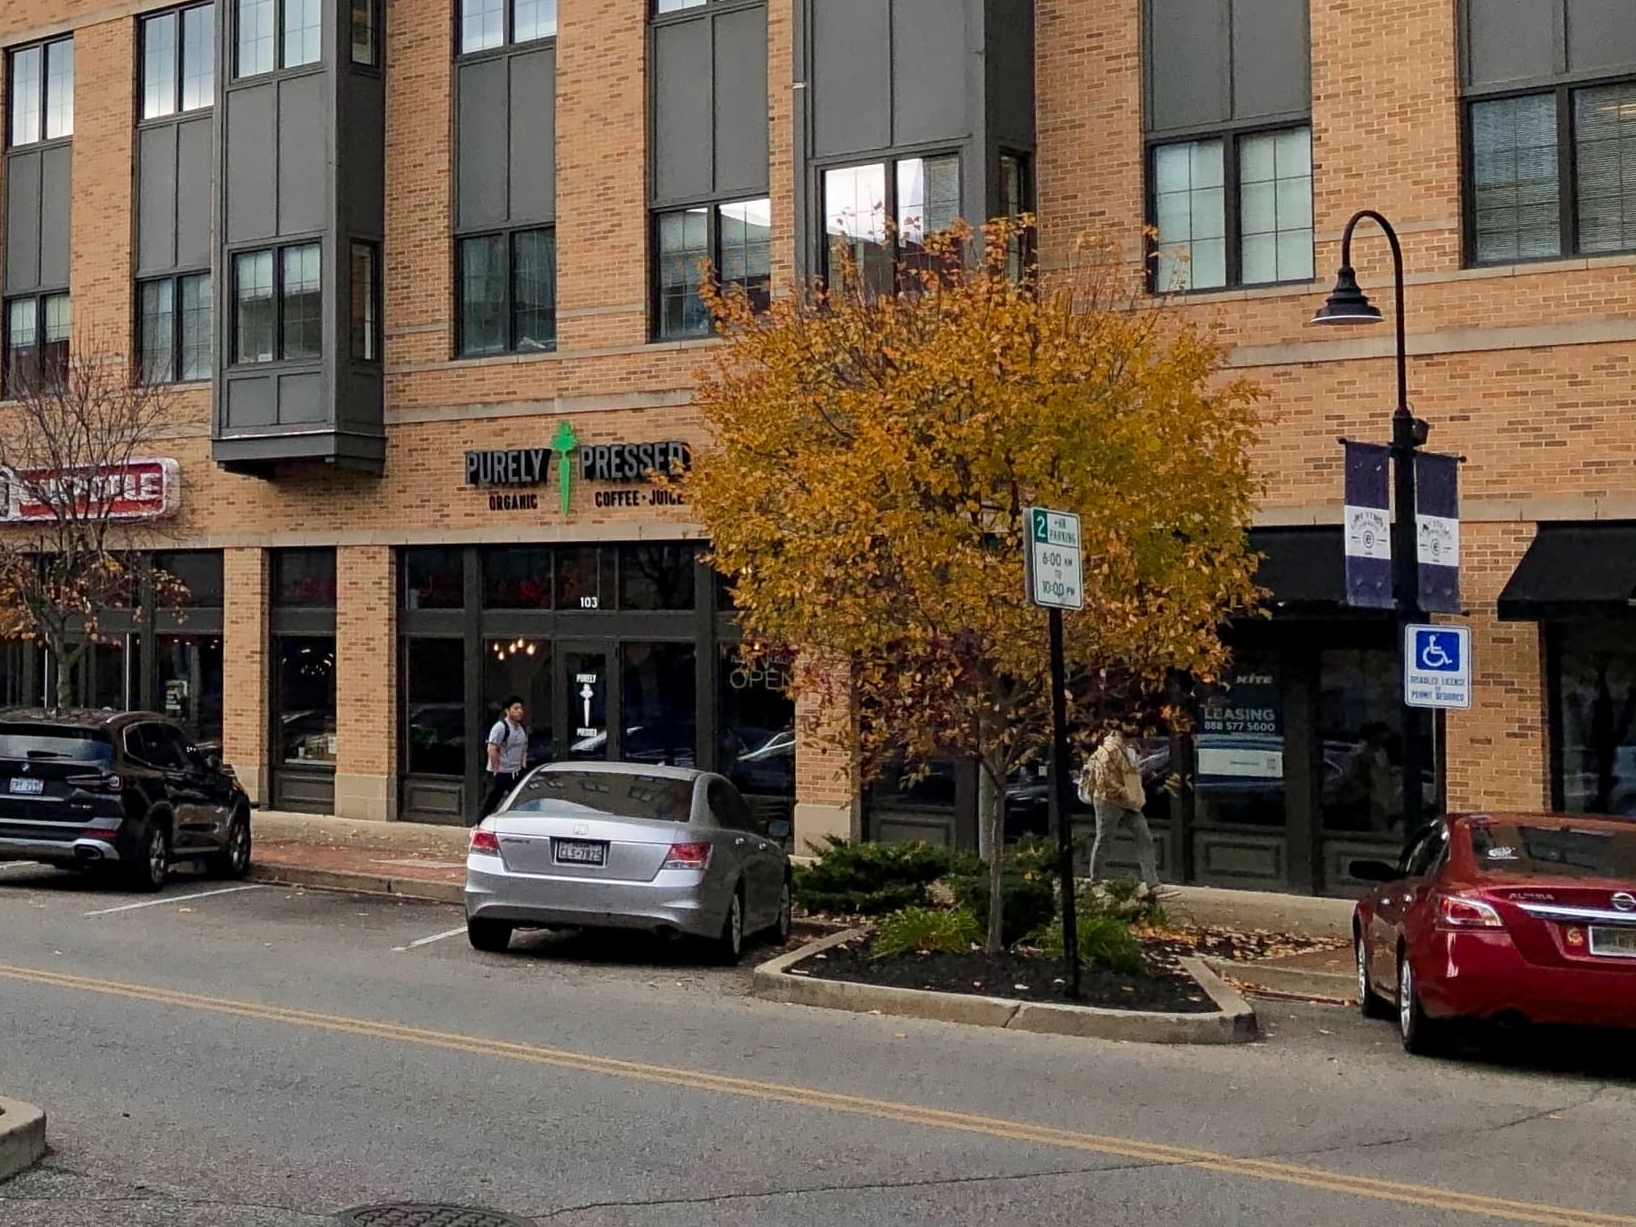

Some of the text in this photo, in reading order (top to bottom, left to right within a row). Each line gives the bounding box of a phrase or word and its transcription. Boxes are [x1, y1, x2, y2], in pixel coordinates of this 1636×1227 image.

[466, 440, 688, 485] PURELY PRESSED
[489, 494, 538, 511] ORGANIC
[595, 491, 639, 508] COFFEE
[1036, 515, 1047, 538] 2
[580, 597, 598, 608] 103
[1204, 707, 1275, 722] LEASING
